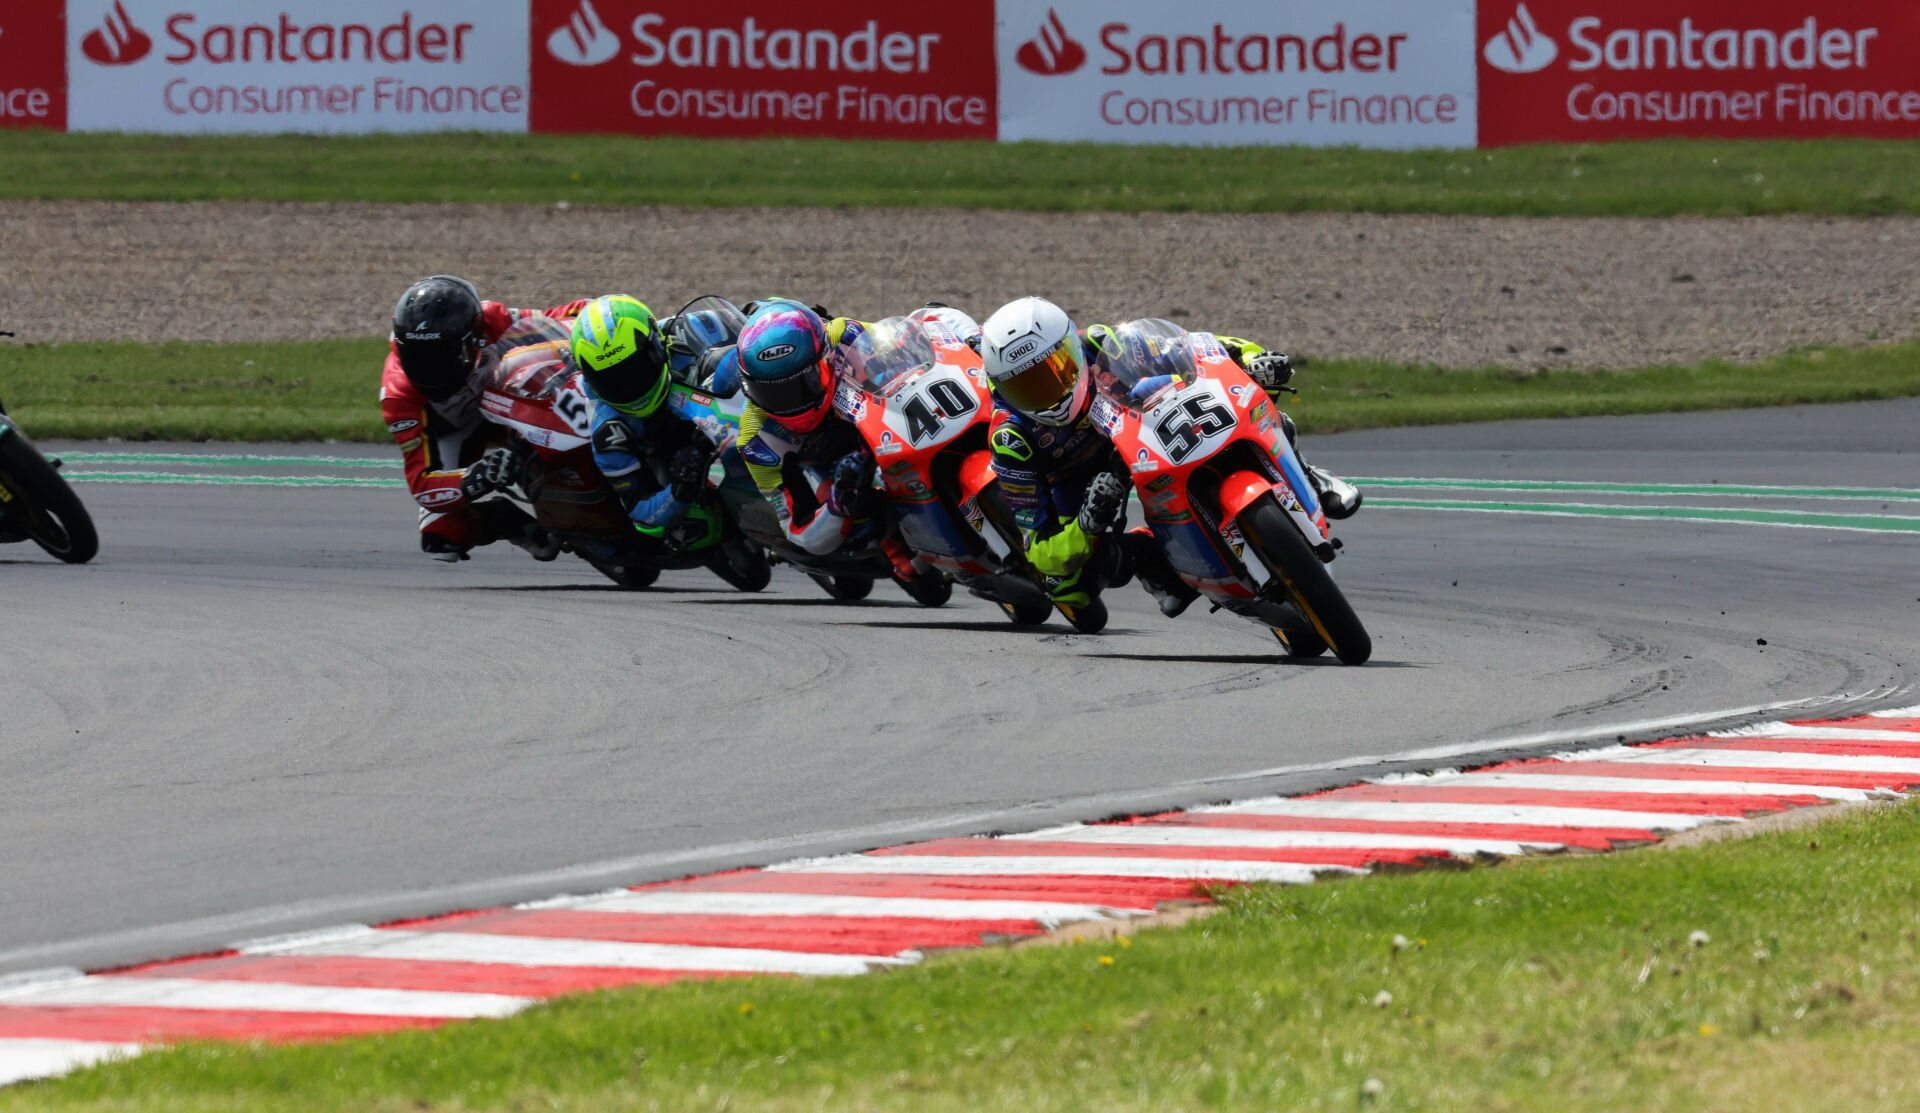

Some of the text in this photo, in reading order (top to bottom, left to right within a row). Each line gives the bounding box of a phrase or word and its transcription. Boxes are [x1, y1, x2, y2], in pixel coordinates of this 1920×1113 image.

[165, 12, 475, 66] Santander
[632, 13, 941, 73] Santander
[1099, 22, 1409, 77] Santander
[1568, 15, 1879, 72] Santander
[164, 78, 523, 116] Consumer Finance
[631, 80, 987, 127] Consumer Finance
[1100, 88, 1458, 126] Consumer Finance
[1567, 83, 1920, 121] Consumer Finance
[405, 332, 441, 340] SHARK
[596, 344, 627, 361] SHARK
[762, 346, 791, 360] HJC
[1009, 342, 1034, 361] SHOEI
[1014, 360, 1035, 376] BIKERS
[1034, 346, 1057, 364] CENTRE
[902, 377, 978, 446] 40
[1153, 392, 1238, 465] 55
